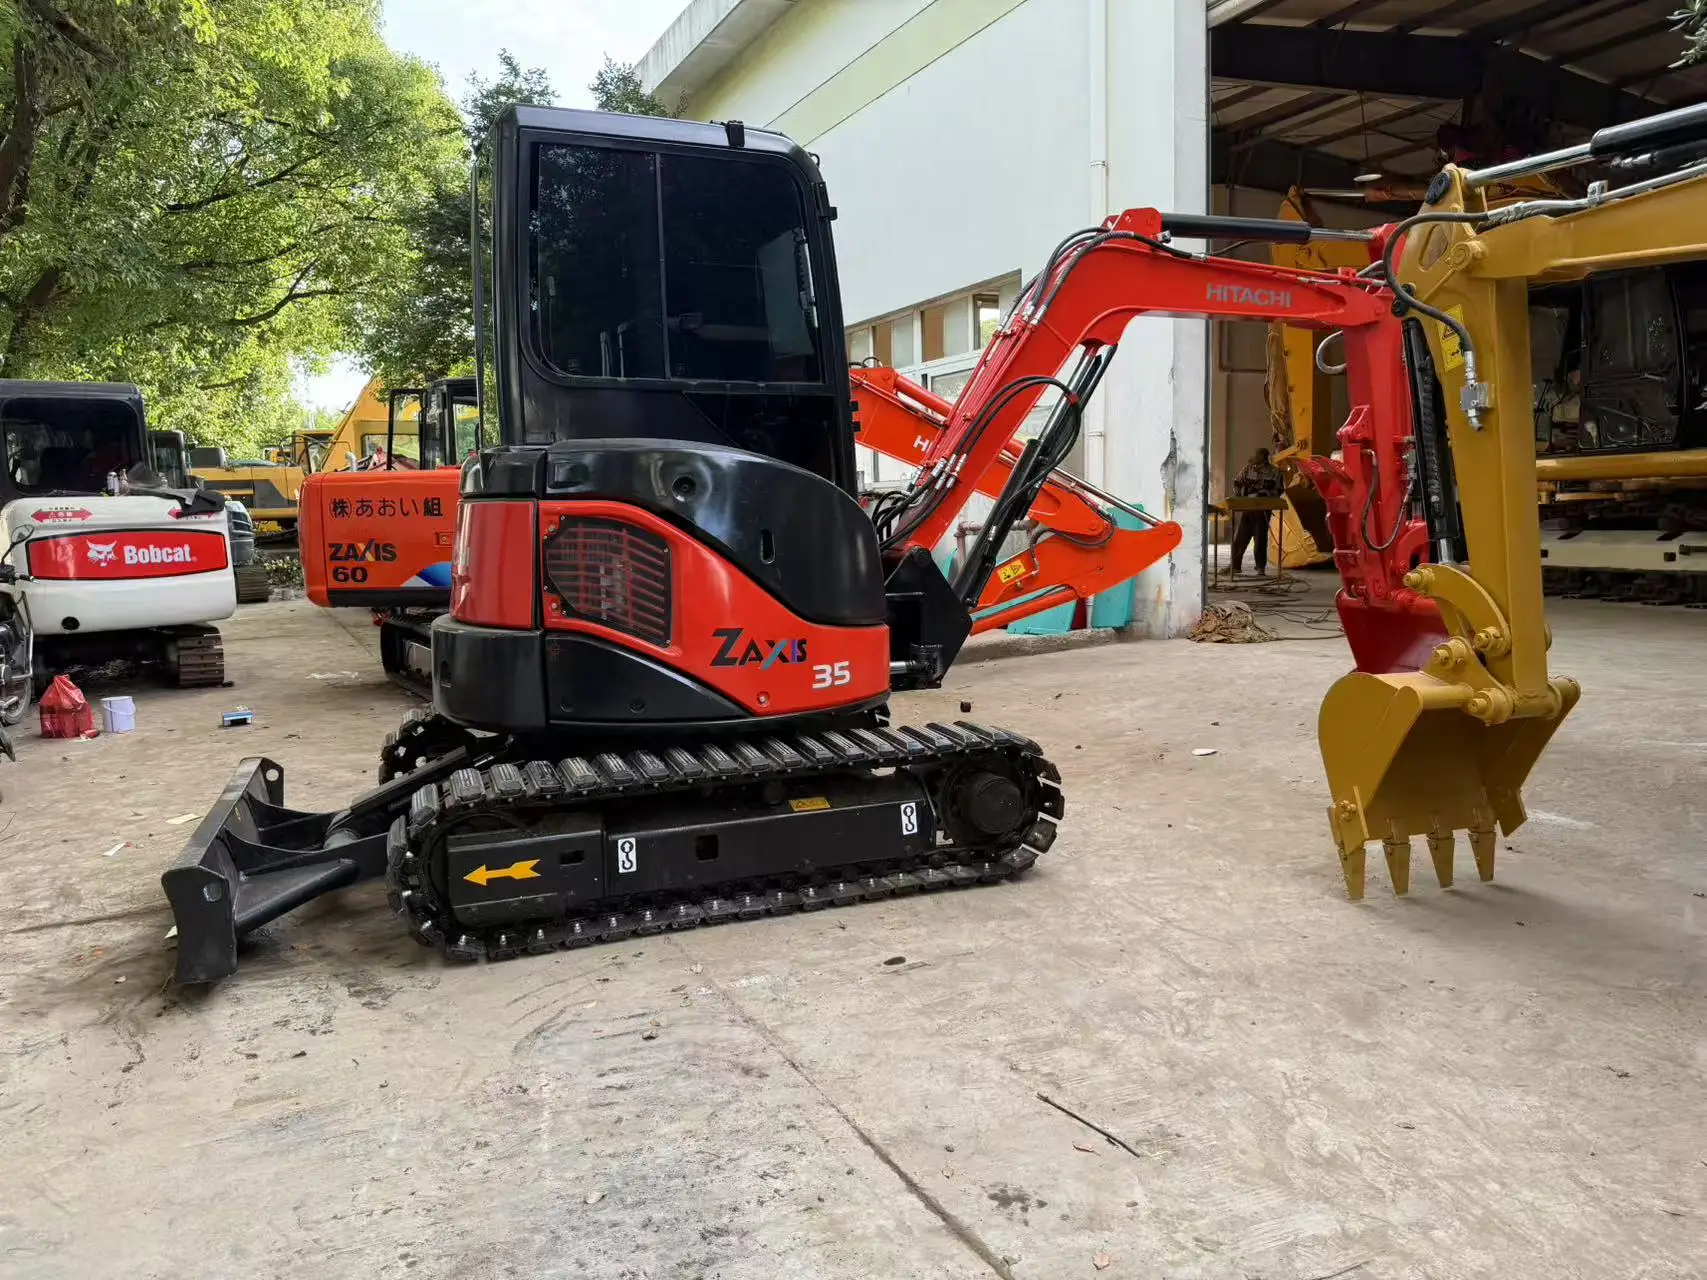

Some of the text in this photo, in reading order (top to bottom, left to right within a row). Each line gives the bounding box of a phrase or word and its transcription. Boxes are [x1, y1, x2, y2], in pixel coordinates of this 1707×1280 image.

[1206, 284, 1292, 308] HITACHI
[124, 544, 192, 565] Bobcat
[328, 539, 397, 562] ZAXIS
[333, 566, 368, 583] 60
[709, 627, 808, 671] ZAXIS
[812, 660, 851, 689] 35
